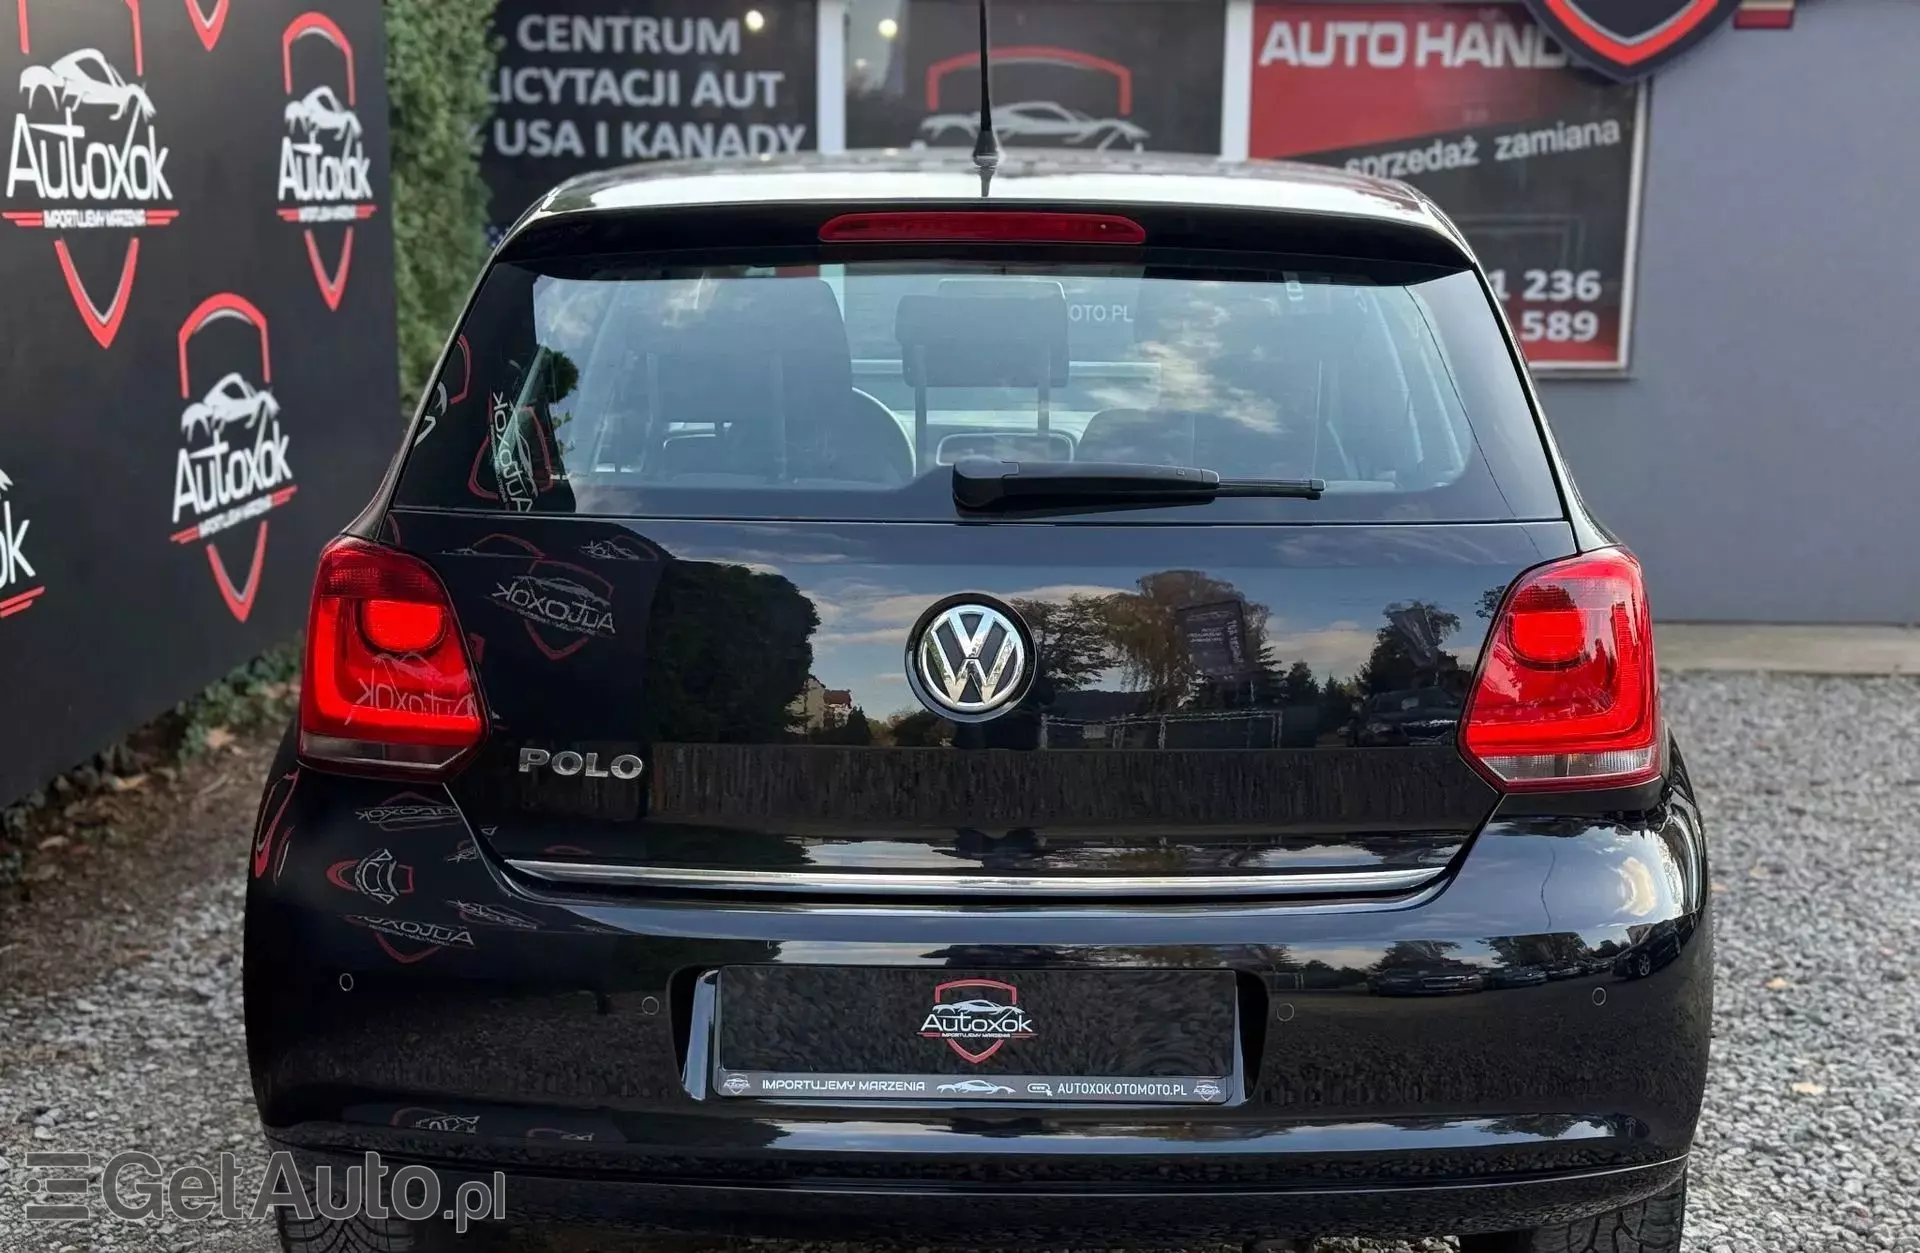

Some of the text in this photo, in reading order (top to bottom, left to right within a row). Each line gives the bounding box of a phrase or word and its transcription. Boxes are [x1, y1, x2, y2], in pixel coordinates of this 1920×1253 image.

[516, 15, 742, 55] CENTRUM
[1258, 20, 1405, 67] AUTO
[690, 70, 784, 108] AUT
[5, 106, 173, 200] Autoxok
[493, 118, 585, 157] USA
[595, 122, 610, 157] I
[620, 122, 806, 160] KANADY
[1493, 118, 1621, 161] zamiana
[1522, 269, 1602, 301] 236
[1068, 304, 1134, 322] OTO.PL
[1521, 311, 1598, 342] 589
[172, 421, 293, 523] Autoxok
[518, 747, 643, 780] POLO
[920, 1012, 1033, 1032] Autoxok
[762, 1079, 856, 1090] IMPORTUJEMY
[858, 1081, 925, 1091] MARZENIA
[1057, 1083, 1188, 1096] AUTOXOK.OTOMOTO.PL
